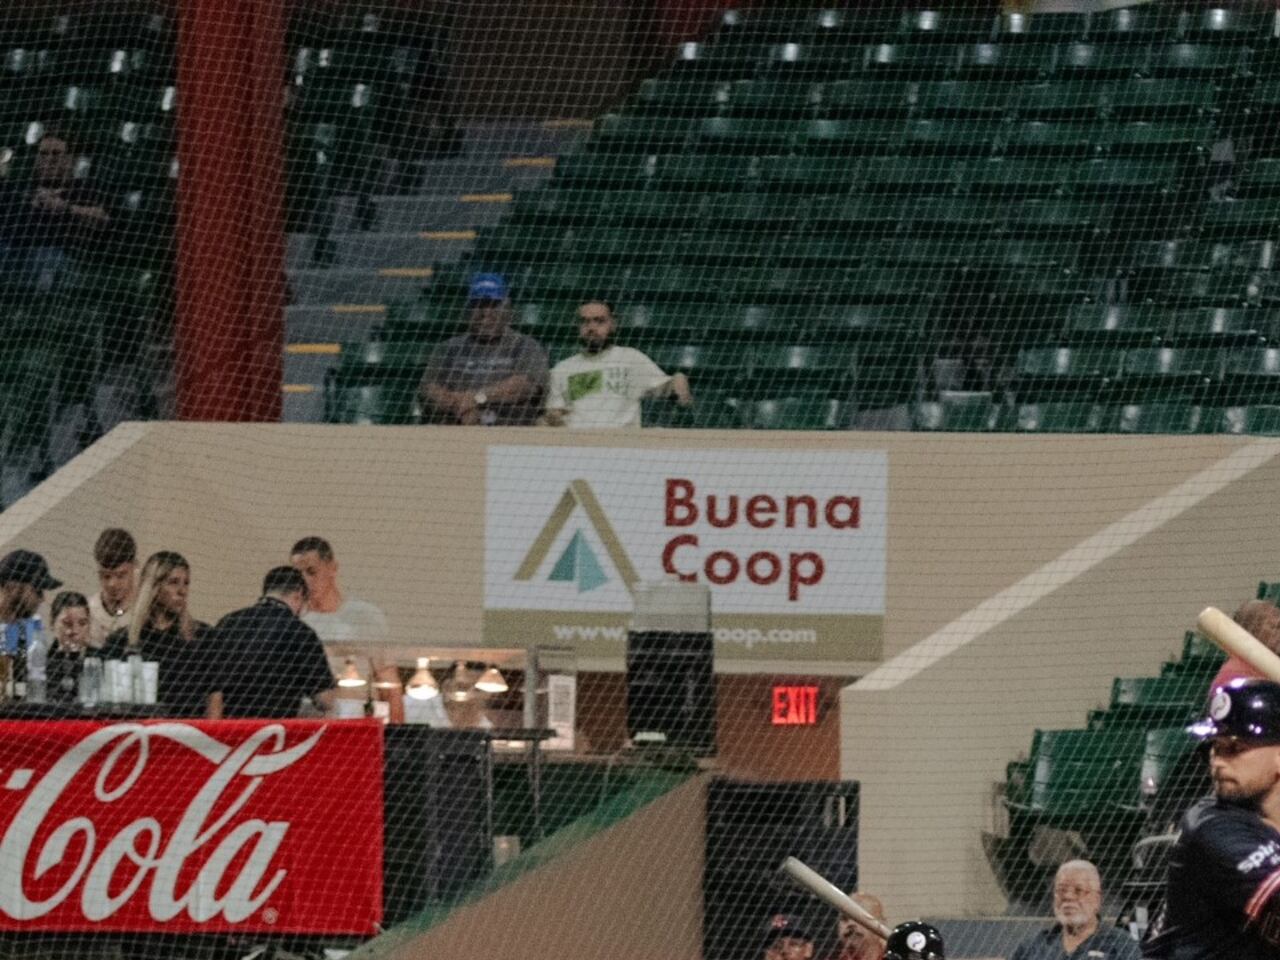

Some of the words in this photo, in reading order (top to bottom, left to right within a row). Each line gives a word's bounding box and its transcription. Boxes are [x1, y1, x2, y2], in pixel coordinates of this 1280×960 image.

[664, 478, 862, 530] Buena
[661, 533, 826, 601] Coop
[771, 686, 819, 725] EXIT
